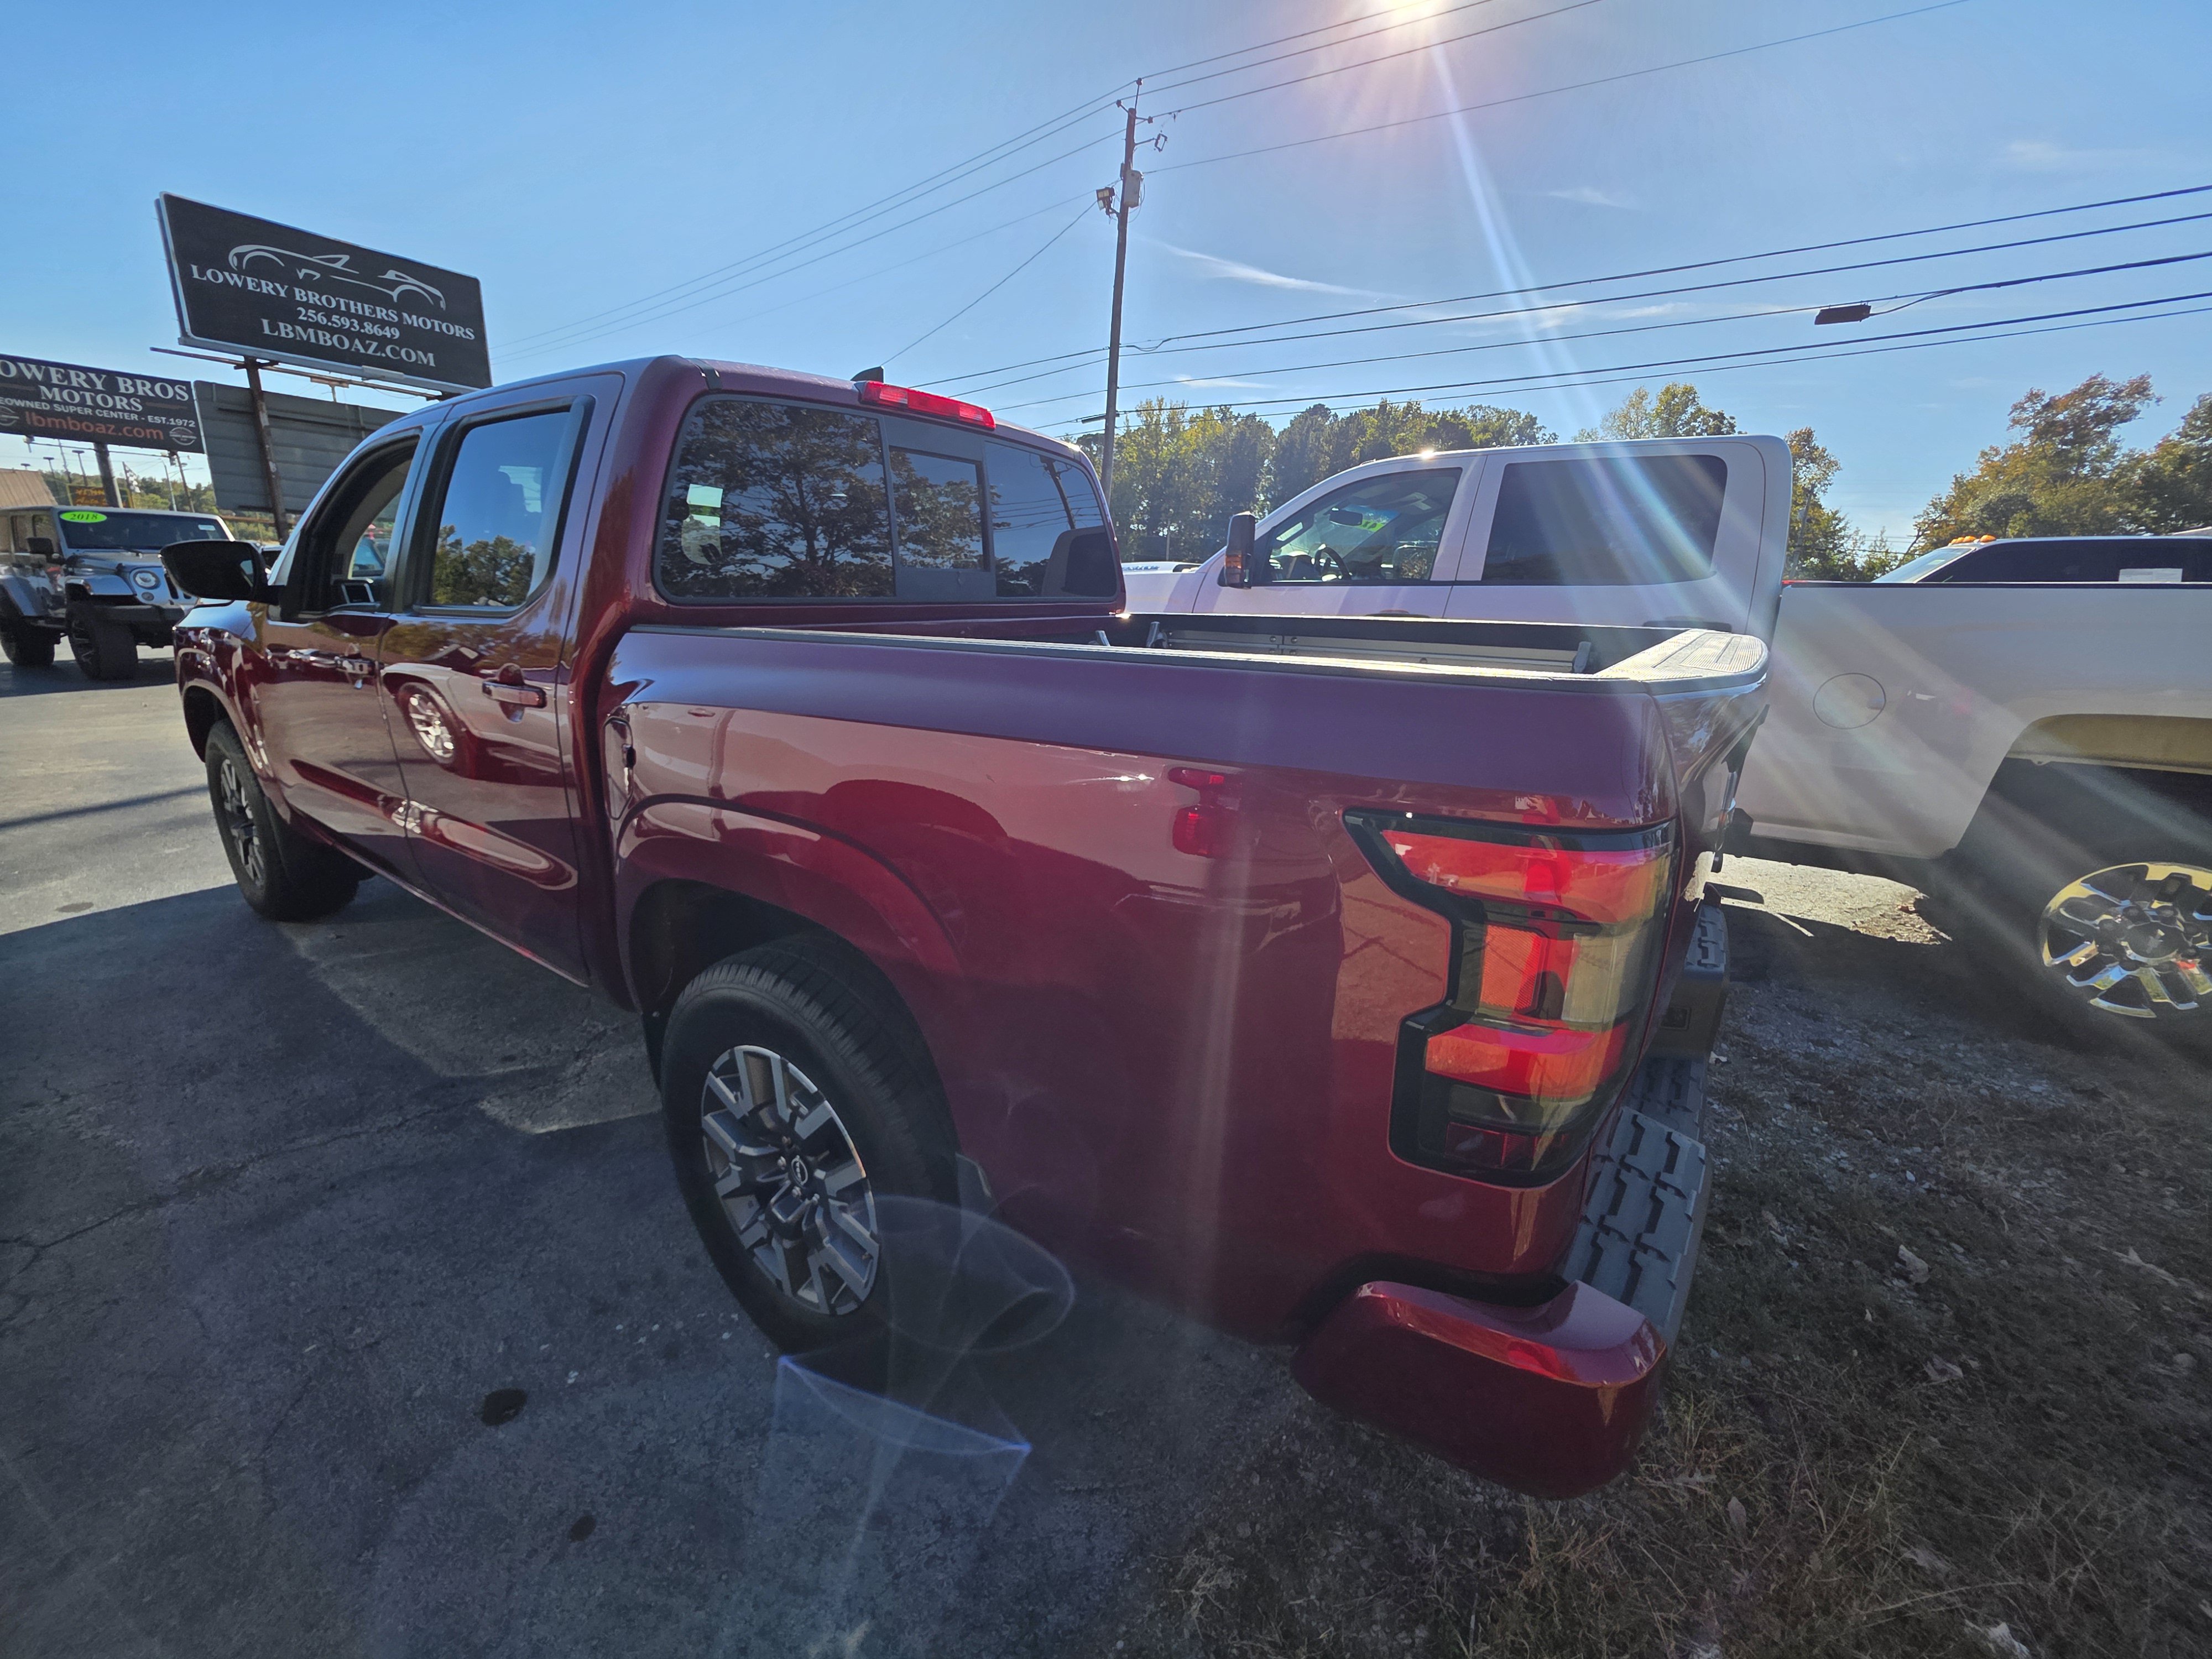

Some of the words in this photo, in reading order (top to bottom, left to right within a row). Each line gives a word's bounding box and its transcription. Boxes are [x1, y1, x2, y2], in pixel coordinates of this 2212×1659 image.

[190, 264, 289, 298] LOWERY
[293, 286, 399, 323] BROTHERS
[401, 311, 476, 340] MOTORS
[296, 306, 400, 340] 256.593.8649
[260, 318, 436, 367] LBMBOAZ.COM
[38, 384, 143, 412] MOTORS
[115, 375, 189, 401] BROS
[25, 411, 164, 440] lbmboaz.com
[53, 403, 93, 415] SUPER
[95, 408, 139, 421] CENTER
[147, 415, 196, 428] EST.1972
